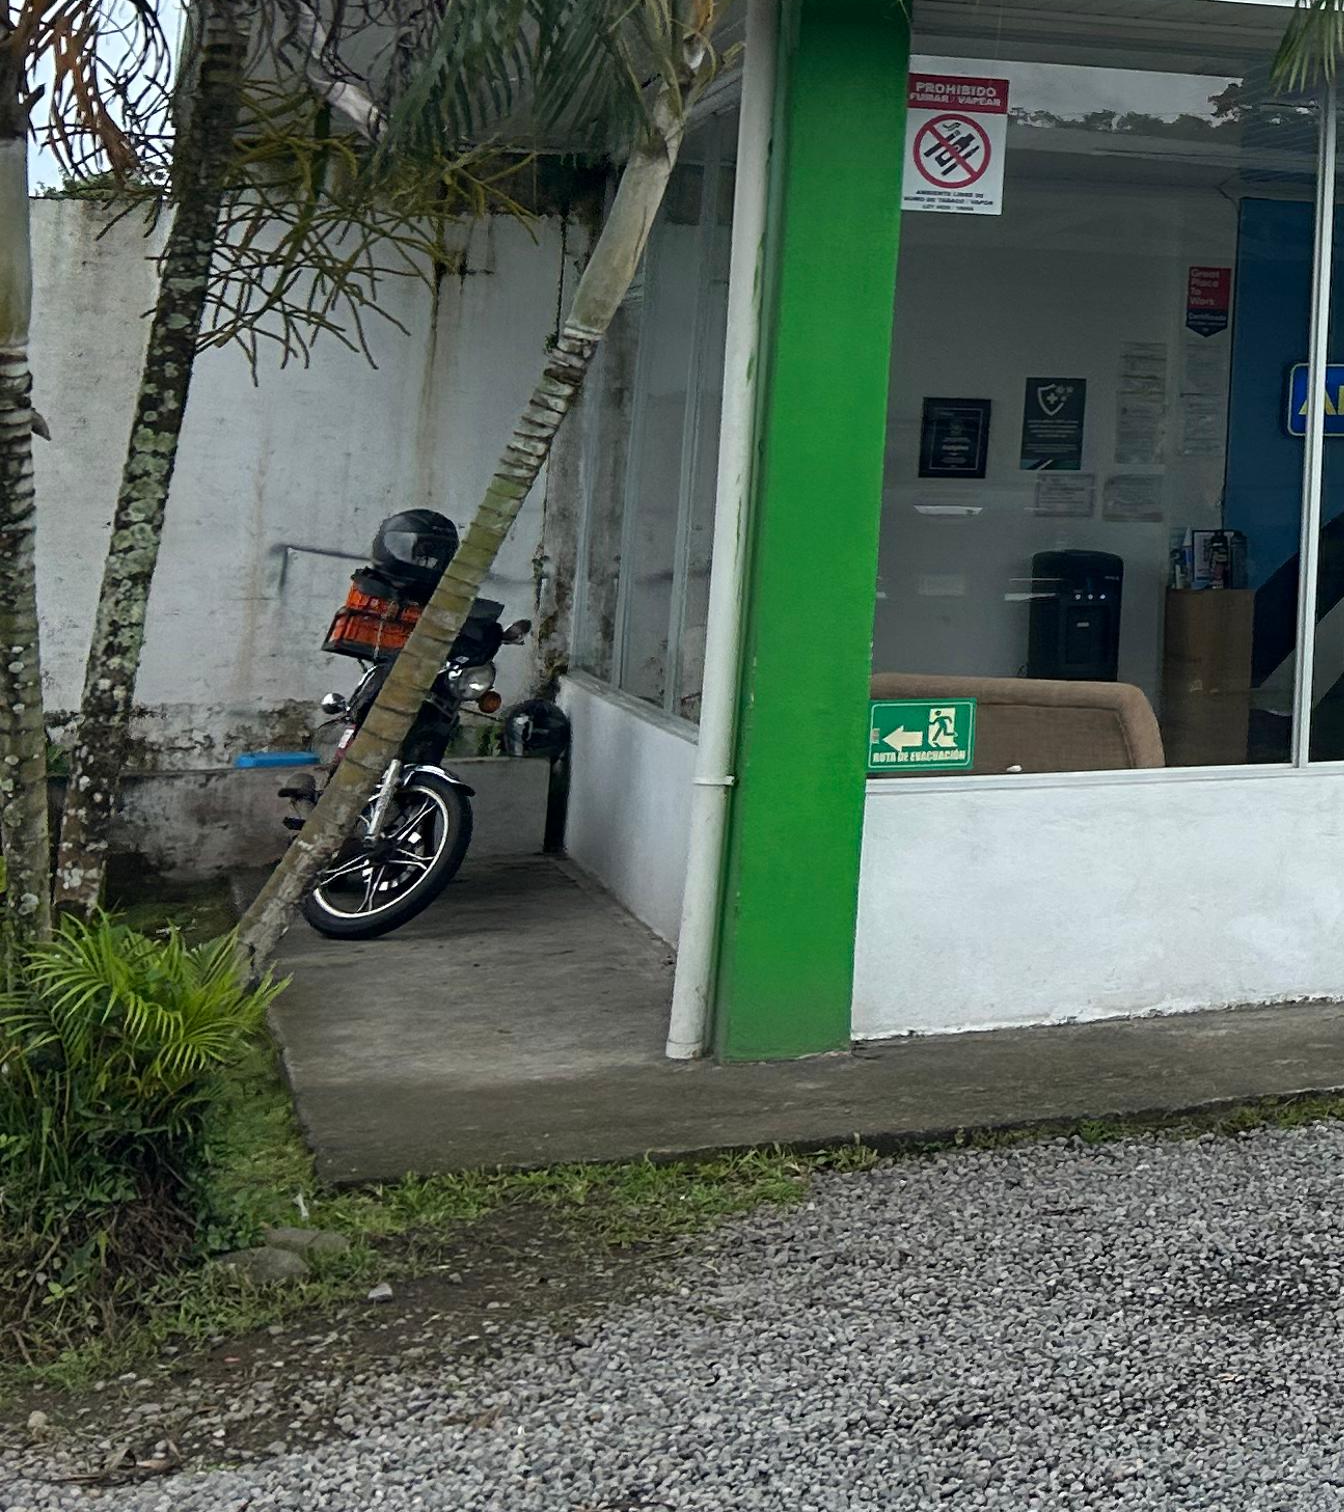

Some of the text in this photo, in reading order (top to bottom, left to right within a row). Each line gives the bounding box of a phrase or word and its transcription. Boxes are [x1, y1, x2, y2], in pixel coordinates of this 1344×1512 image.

[916, 82, 996, 97] PROHIBIDO
[910, 92, 949, 104] FUMAR
[958, 96, 1001, 107] VAPEAR
[1191, 268, 1220, 278] Great
[873, 748, 966, 763] RUTA DE EVACUACIÓN
